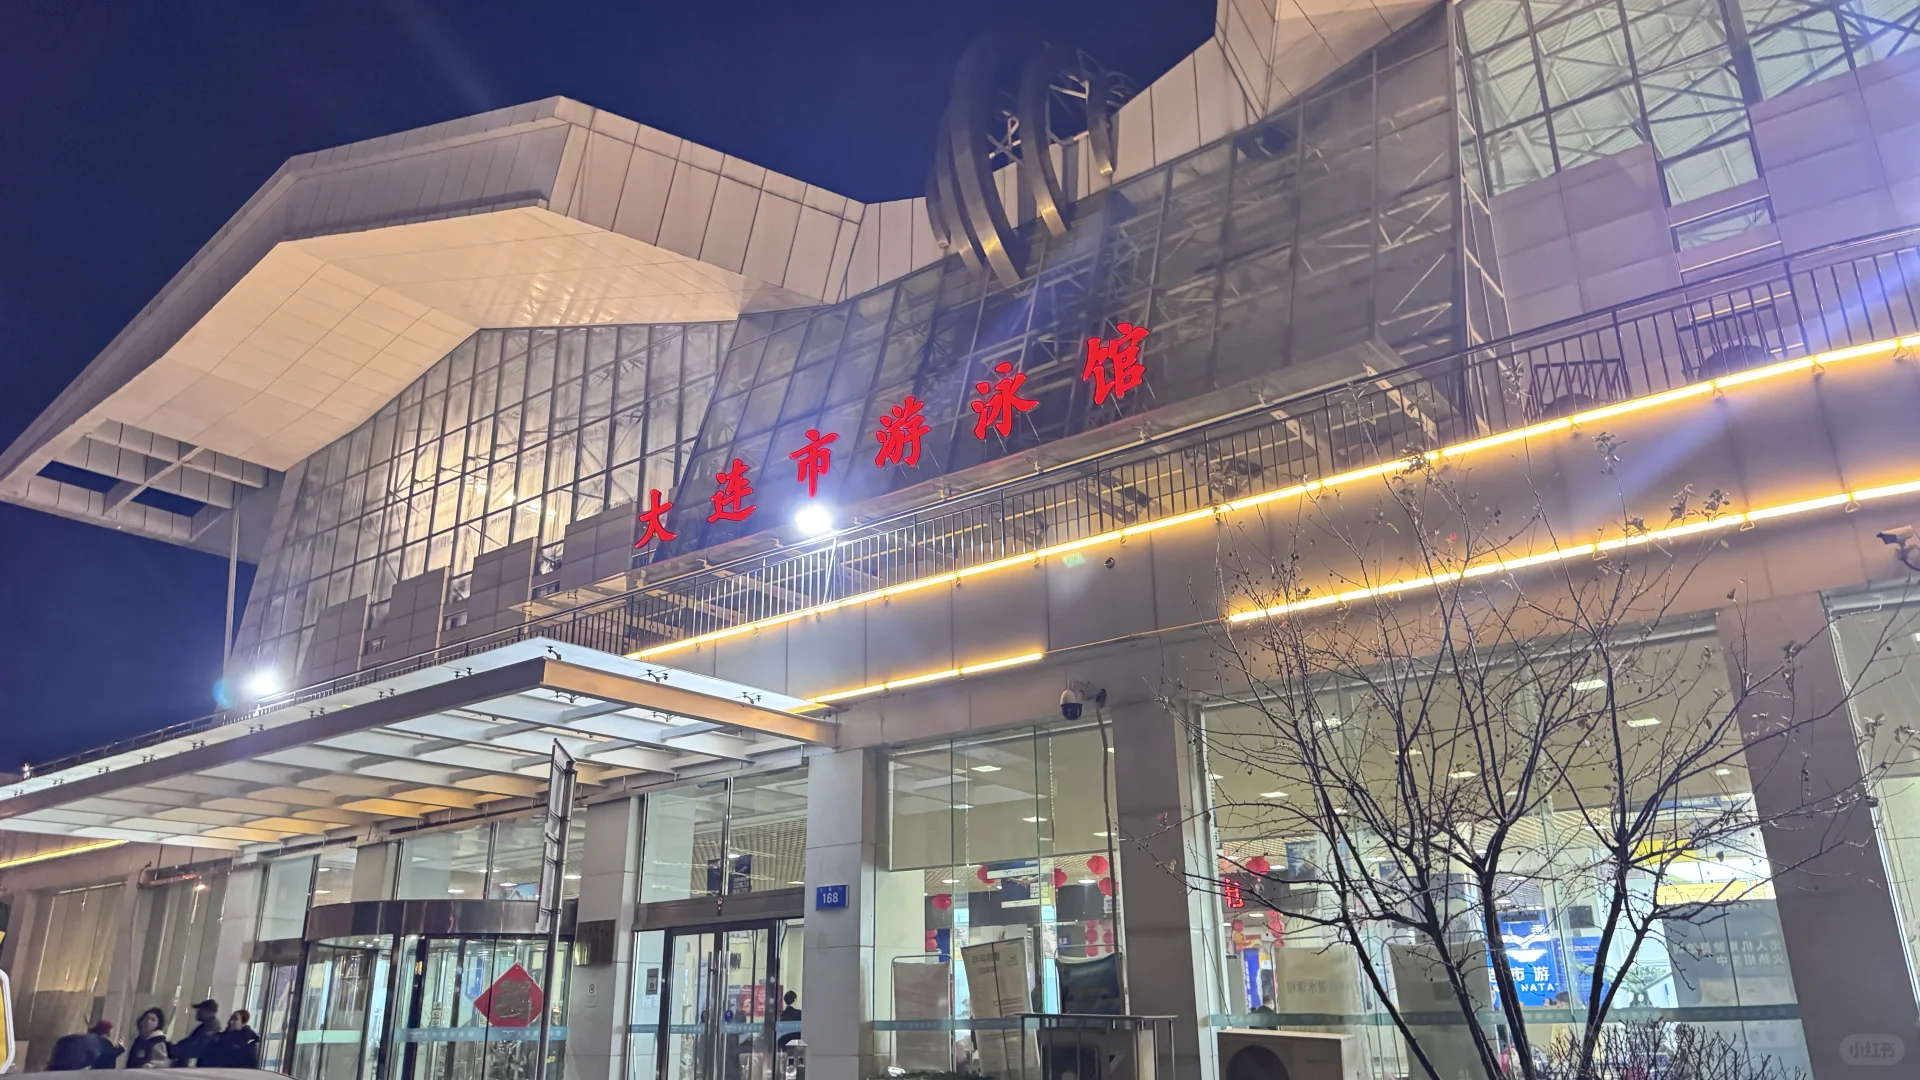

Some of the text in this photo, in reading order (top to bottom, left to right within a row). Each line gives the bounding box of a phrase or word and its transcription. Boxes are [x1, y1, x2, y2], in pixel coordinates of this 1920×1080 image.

[635, 322, 1149, 549] 大连市游泳馆
[822, 892, 839, 904] 168
